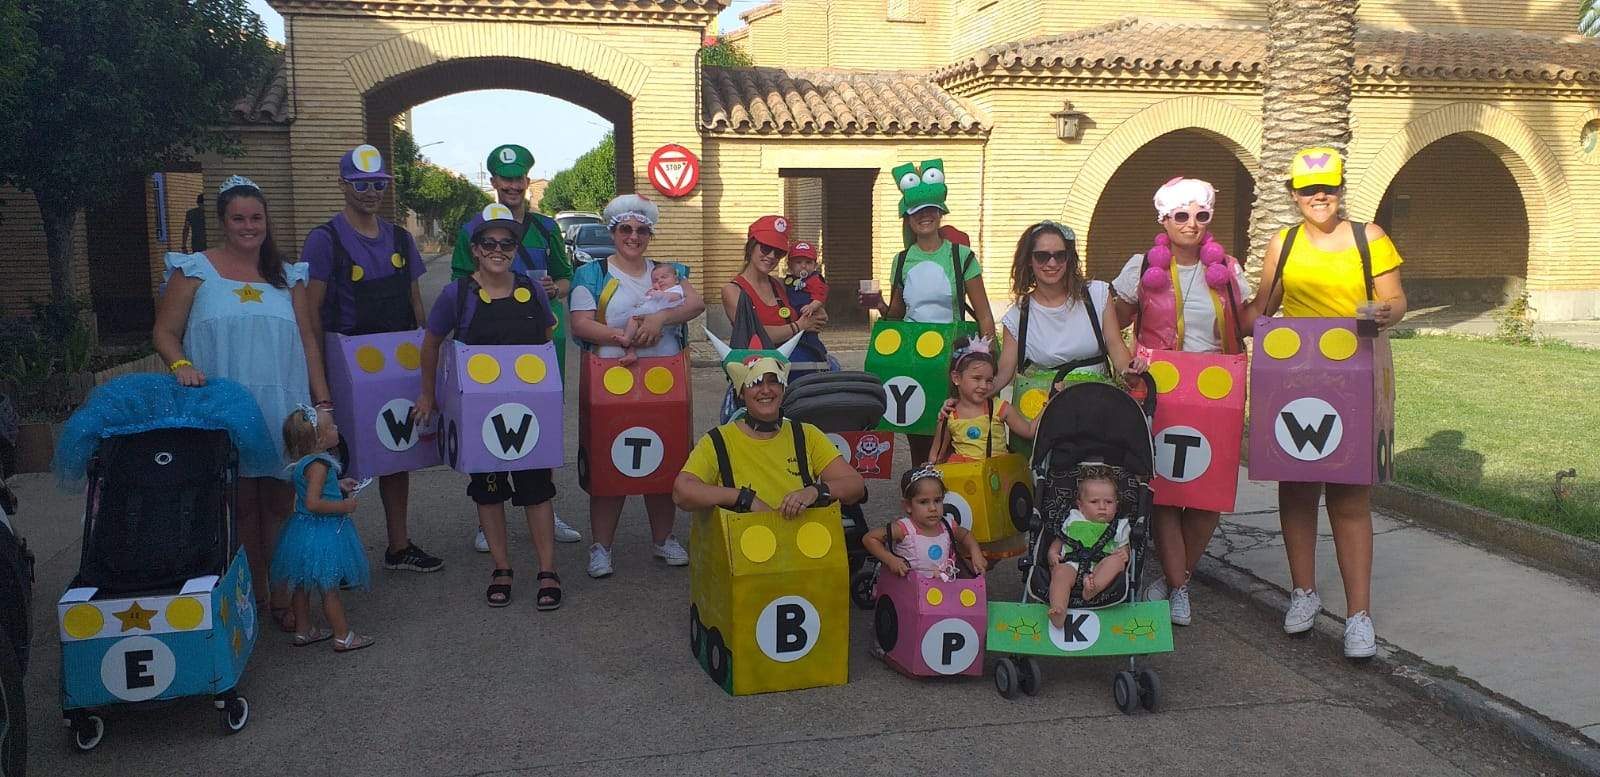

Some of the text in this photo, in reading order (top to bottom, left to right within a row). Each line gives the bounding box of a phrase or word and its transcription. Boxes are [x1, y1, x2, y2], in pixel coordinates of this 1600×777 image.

[503, 151, 512, 161] L
[1302, 153, 1331, 169] W
[777, 220, 785, 228] M
[888, 384, 918, 424] Y
[382, 406, 415, 446] W
[491, 413, 533, 454] W
[1280, 412, 1337, 455] W
[624, 437, 652, 470] T
[1164, 434, 1201, 478] T
[776, 604, 808, 653] B
[941, 632, 966, 665] P
[1064, 614, 1089, 643] K
[125, 650, 155, 690] E
